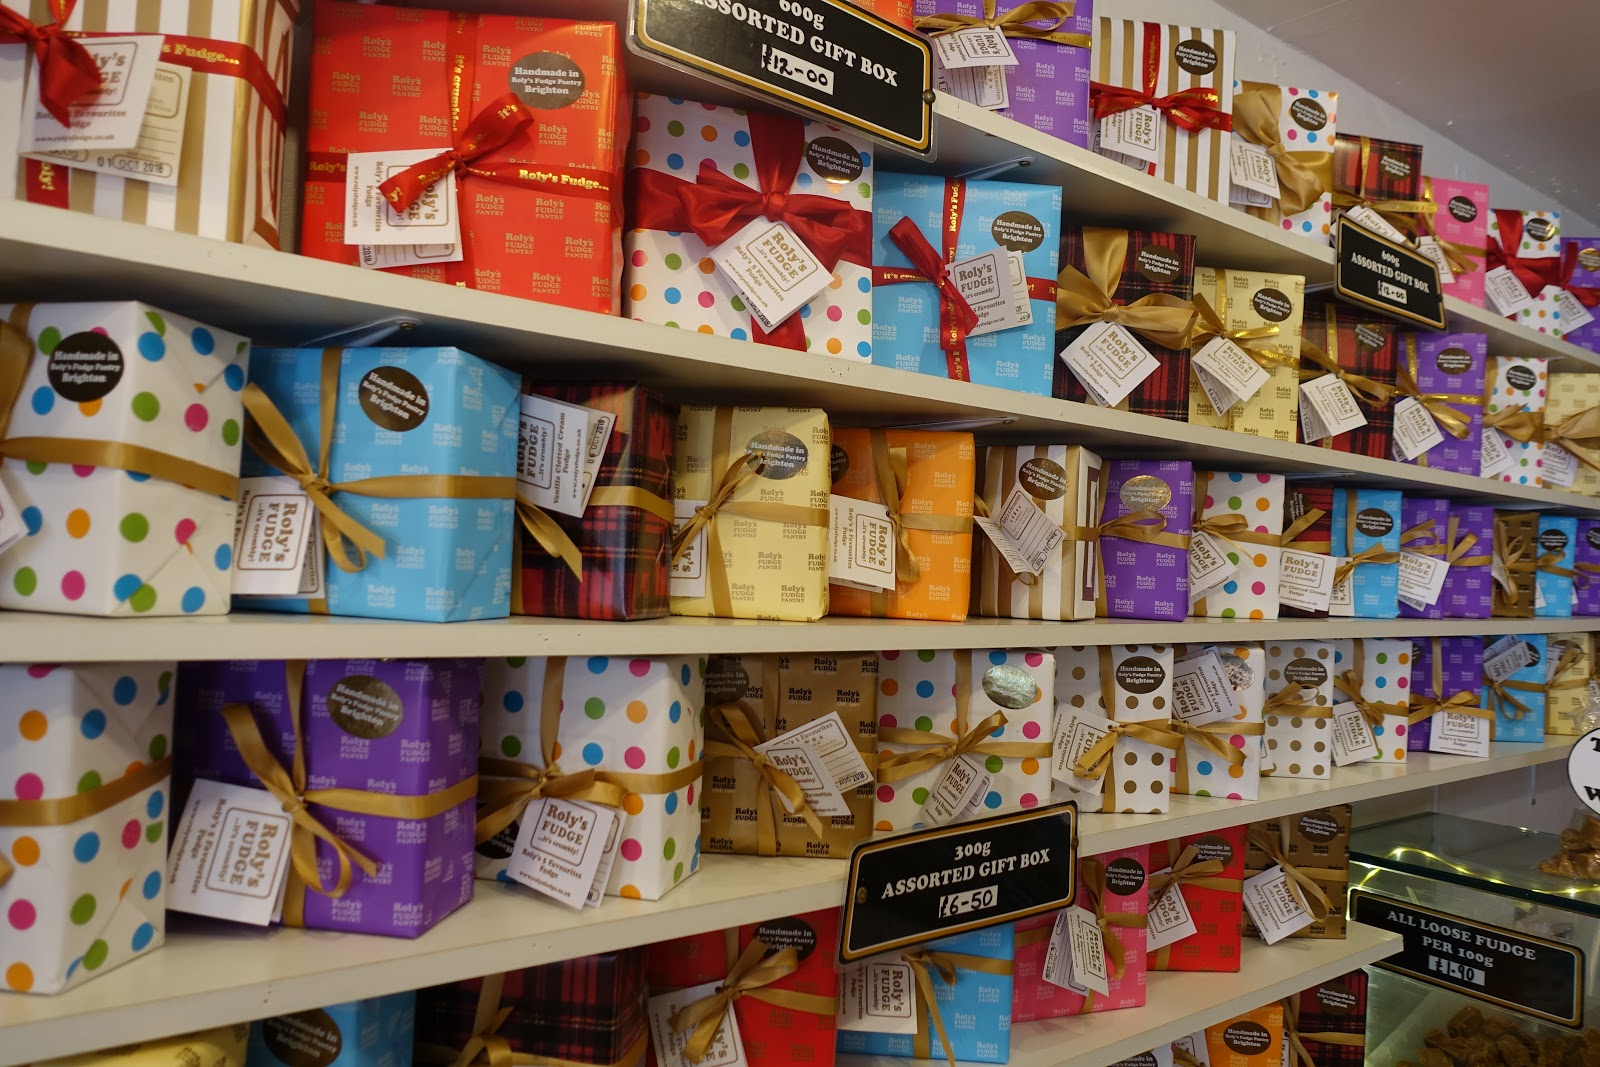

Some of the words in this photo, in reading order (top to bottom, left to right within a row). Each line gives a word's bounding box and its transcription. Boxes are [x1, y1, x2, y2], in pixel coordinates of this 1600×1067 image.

[779, 0, 824, 30] 600g
[362, 45, 392, 54] FUDGE
[363, 36, 392, 48] Roly's
[483, 45, 511, 55] Roly's
[695, 0, 805, 45] SSORTED
[810, 35, 858, 67] GIFT
[860, 58, 898, 87] BOX
[973, 35, 991, 55] FUDGE
[983, 34, 1000, 55] Roly's
[1178, 45, 1208, 57] Handmade
[363, 51, 391, 59] PANTRY
[482, 54, 511, 62] FUDGE
[515, 67, 567, 77] Handmade
[569, 68, 579, 77] in
[525, 85, 569, 95] Brighton
[1016, 86, 1035, 94] Roly's
[539, 124, 567, 133] Roly's
[1134, 111, 1143, 143] FUDGE
[1143, 113, 1153, 145] Roly's
[811, 143, 851, 161] Handmade
[119, 159, 141, 170] OCT
[309, 160, 346, 173] Roly's
[817, 159, 851, 174] Brighton
[519, 169, 558, 183] Roly's
[365, 185, 373, 207] Fudge
[950, 202, 958, 232] Roly's
[996, 219, 1031, 230] Handmade
[1002, 233, 1033, 243] Brighton
[762, 239, 799, 280] FUDGE
[771, 231, 808, 273] Roly's
[1140, 251, 1169, 264] Handmade
[1381, 250, 1400, 268] 600g
[735, 245, 752, 265] Roly's
[756, 266, 785, 302] Favourites
[746, 268, 763, 287] Fudge
[767, 255, 790, 284] crumbly!
[959, 263, 992, 282] Roly's
[1144, 263, 1171, 276] Brighton
[1351, 252, 1394, 278] ASSORTED
[1395, 271, 1413, 286] GIFT
[1414, 278, 1430, 293] BOX
[961, 277, 994, 293] FUDGE
[978, 300, 1006, 312] Favourites
[1259, 304, 1283, 317] Brighton
[1022, 333, 1046, 342] Roly's
[1108, 330, 1138, 362] Roly's
[54, 350, 105, 362] Handmade
[1101, 338, 1131, 368] FUDGE
[1221, 349, 1250, 376] FUDGE
[1226, 345, 1254, 371] Roly's
[1080, 346, 1094, 361] Roly's
[1097, 363, 1121, 388] Favourites
[1089, 364, 1103, 378] Fudge
[62, 372, 107, 384] Brighton
[369, 372, 415, 403] Handmade
[369, 393, 410, 421] Brighton
[1330, 386, 1351, 416] FUDGE
[1337, 383, 1354, 413] Roly's
[1414, 407, 1431, 434] Roly's
[527, 424, 539, 479] FUDGE
[540, 427, 548, 460] crumbly!
[751, 441, 794, 453] Handmade
[795, 446, 805, 454] in
[555, 445, 563, 475] Clotted
[562, 448, 571, 474] Fudge
[766, 451, 784, 459] Fudge
[785, 453, 806, 462] Pantry
[934, 471, 956, 481] Roly's
[1026, 462, 1061, 482] Handmade
[553, 476, 561, 505] Vanilla
[1026, 477, 1055, 493] Brighton
[258, 501, 280, 564] FUDGE
[274, 501, 298, 564] Roly's
[733, 520, 757, 528] Roly's
[868, 521, 877, 565] FUDGE
[878, 523, 888, 568] Roly's
[1193, 536, 1219, 567] Roly's
[758, 551, 783, 560] Roly's
[1117, 551, 1136, 560] Roly's
[1285, 556, 1320, 569] Roly's
[1401, 554, 1432, 569] Roly's
[1284, 566, 1318, 577] FUDGE
[814, 658, 837, 667] Roly's
[814, 664, 837, 672] FUDGE
[1287, 665, 1317, 673] Handmade
[336, 683, 384, 710] Handmade
[788, 687, 812, 696] Roly's
[1180, 680, 1199, 711] FUDGE
[340, 705, 384, 728] Brighton
[1446, 712, 1476, 722] Roly's
[1446, 720, 1476, 730] FUDGE
[800, 723, 833, 740] Favourites
[1346, 716, 1362, 747] FUDGE
[1353, 714, 1367, 745] Roly's
[773, 755, 806, 767] Roly's
[951, 762, 971, 785] Roly's
[945, 773, 964, 795] FUDGE
[547, 804, 588, 830] Roly's
[542, 821, 583, 845] FUDGE
[229, 820, 252, 886] FUDGE
[247, 823, 279, 889] Roly's
[552, 841, 579, 855] crumbly!
[954, 841, 992, 861] 300g
[522, 848, 541, 861] Roly's
[548, 859, 582, 879] Favourites
[540, 866, 558, 878] Fudge
[1108, 866, 1135, 874] Handmade
[881, 864, 975, 900] ASSORTED
[978, 857, 1017, 876] GIFT
[1020, 848, 1050, 869] BOX
[1273, 884, 1294, 915] FUDGE
[759, 927, 802, 936] Handmade
[1387, 910, 1417, 927] ALL
[1419, 918, 1472, 943] LOOSE
[1475, 934, 1537, 961] FUDGE
[1422, 935, 1453, 954] PER
[1458, 948, 1494, 968] 100g
[881, 969, 891, 1011] FUDGE
[892, 970, 904, 1012] Roly's
[1228, 1028, 1260, 1037] Handmade
